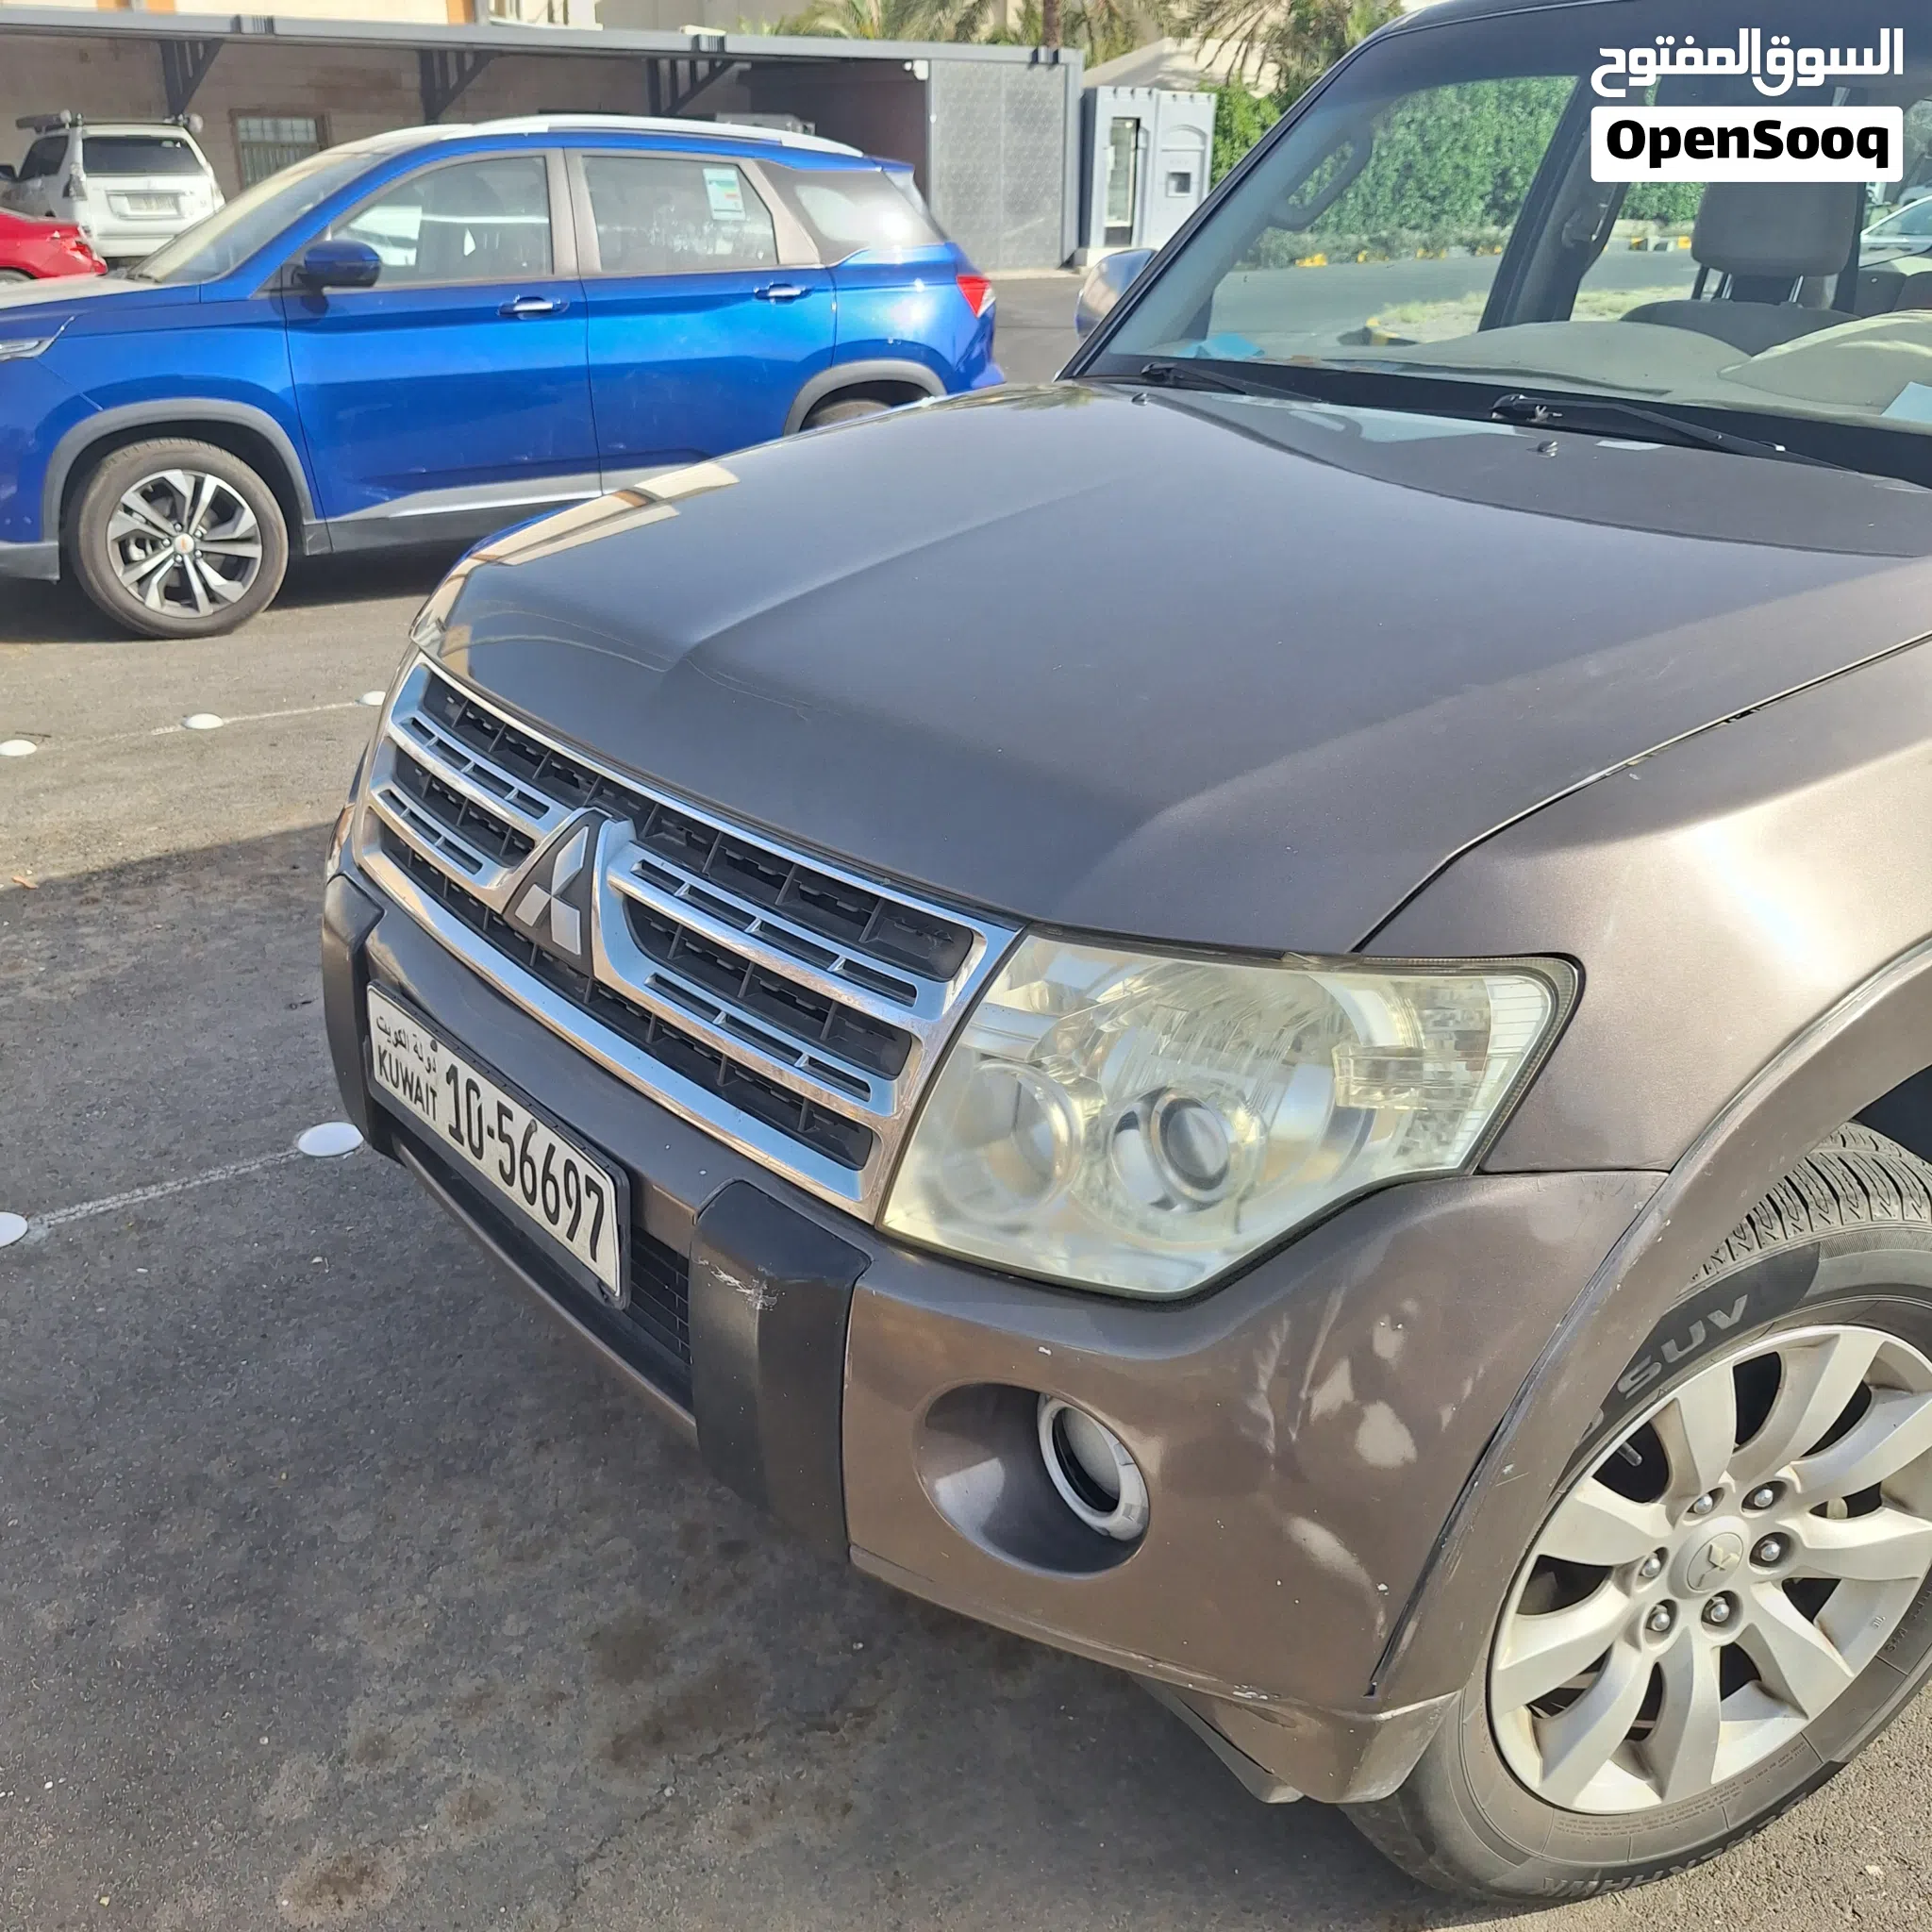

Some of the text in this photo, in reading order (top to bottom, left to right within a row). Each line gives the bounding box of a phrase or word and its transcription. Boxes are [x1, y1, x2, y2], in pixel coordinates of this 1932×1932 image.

[377, 1043, 438, 1122] KUWAIT
[446, 1062, 606, 1263] 10-56697
[1617, 1293, 1749, 1400] SUV
